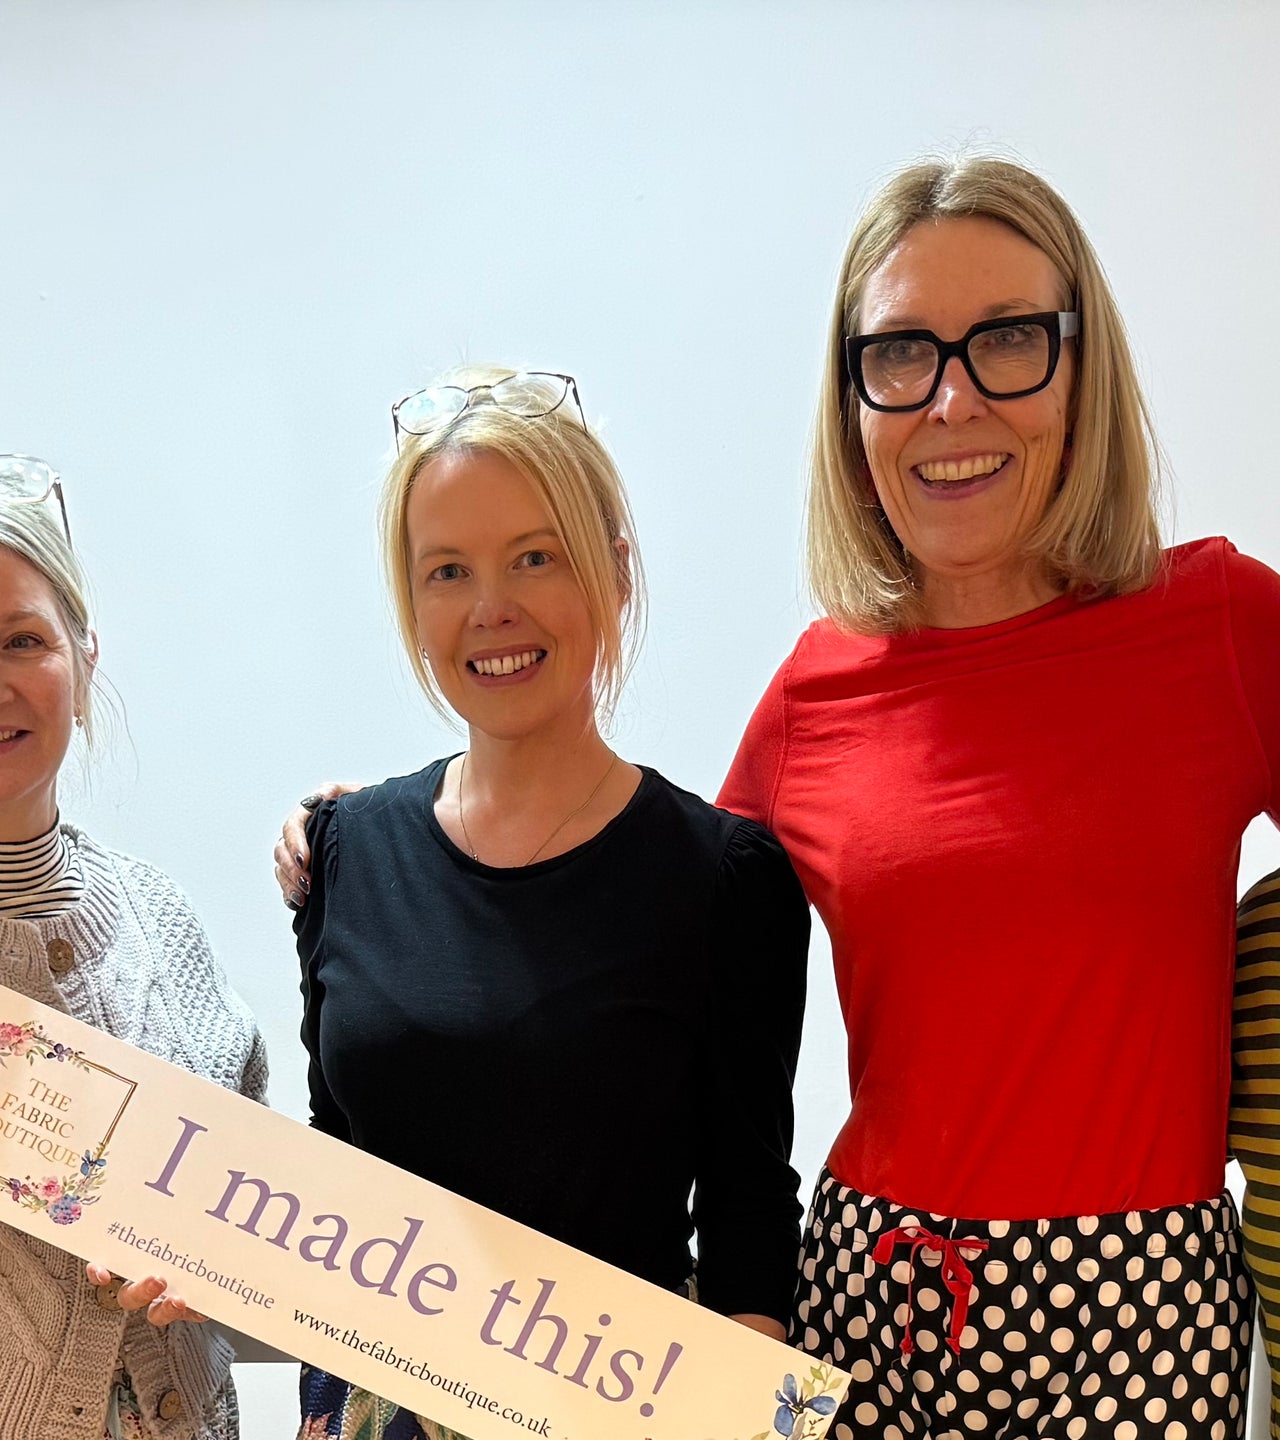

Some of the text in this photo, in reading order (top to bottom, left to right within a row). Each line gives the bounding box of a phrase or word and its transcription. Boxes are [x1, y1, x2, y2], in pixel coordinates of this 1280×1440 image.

[0, 1091, 75, 1139] FABRIC
[27, 1077, 73, 1113] THE
[107, 1222, 276, 1311] #thefabricboutique
[145, 1116, 683, 1418] I made this!
[292, 1309, 552, 1440] www.thefabricboutique.co.uk
